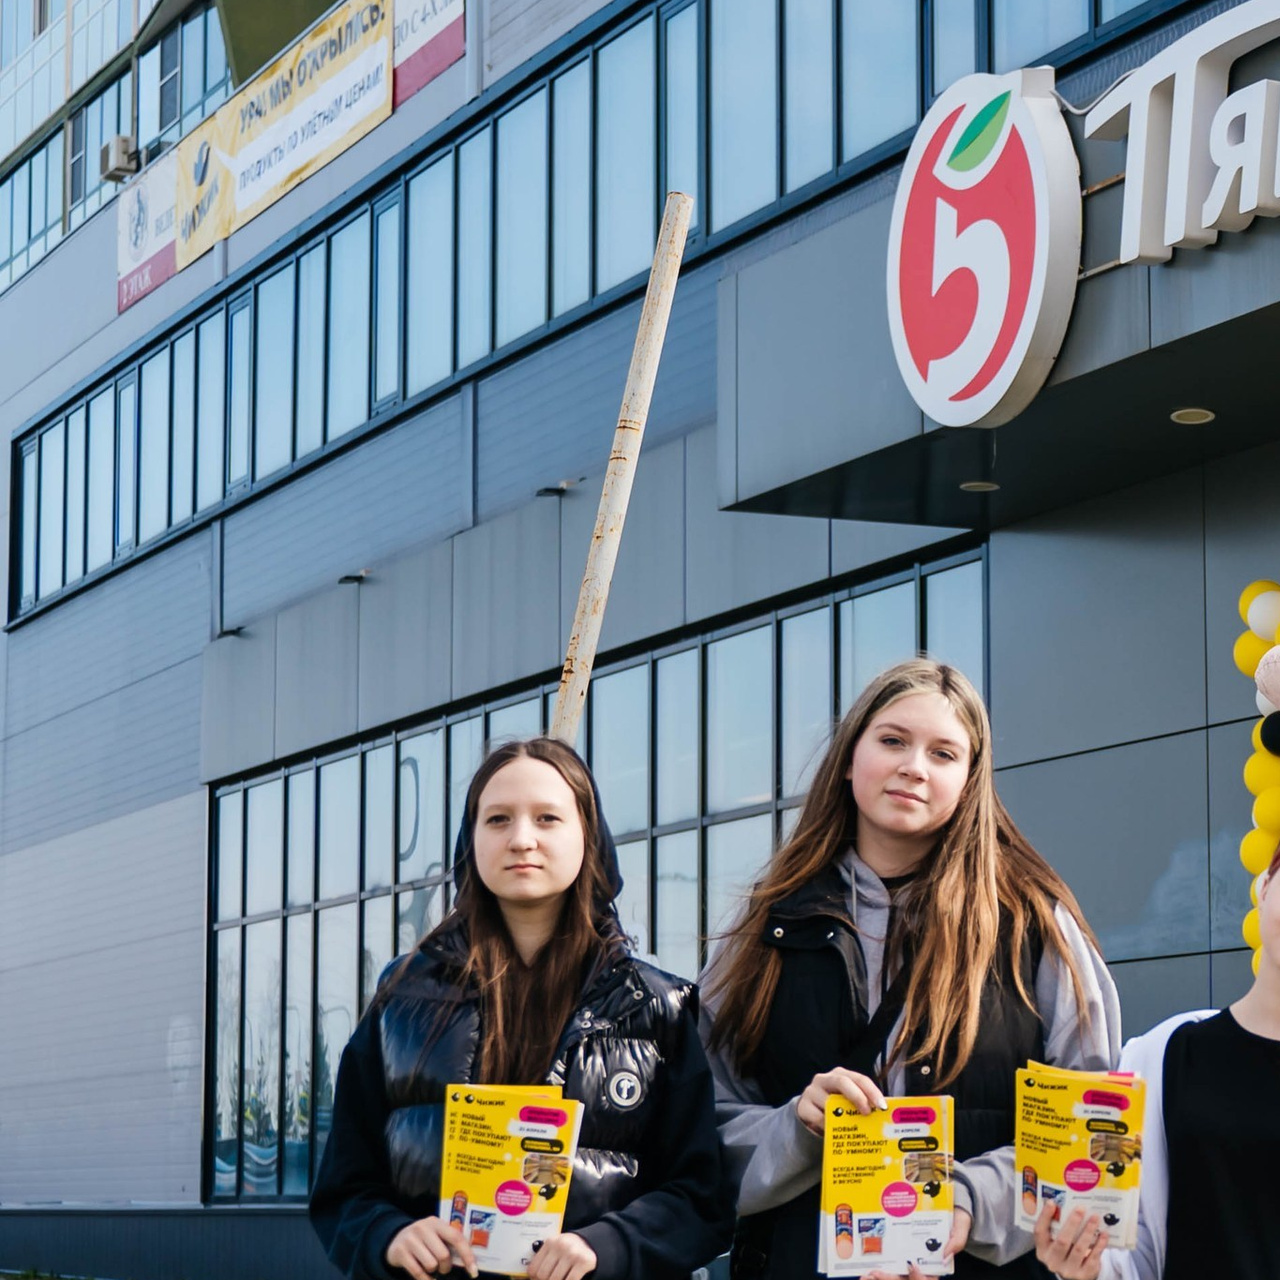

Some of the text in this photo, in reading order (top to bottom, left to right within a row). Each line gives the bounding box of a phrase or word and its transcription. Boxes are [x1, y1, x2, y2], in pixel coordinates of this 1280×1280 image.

[270, 68, 293, 111] МЫ
[239, 62, 384, 192] ПРОДУКТЫ ПО УЛЁТНЫМ ЦЕНАМ!
[461, 1112, 486, 1122] НОВЫЙ
